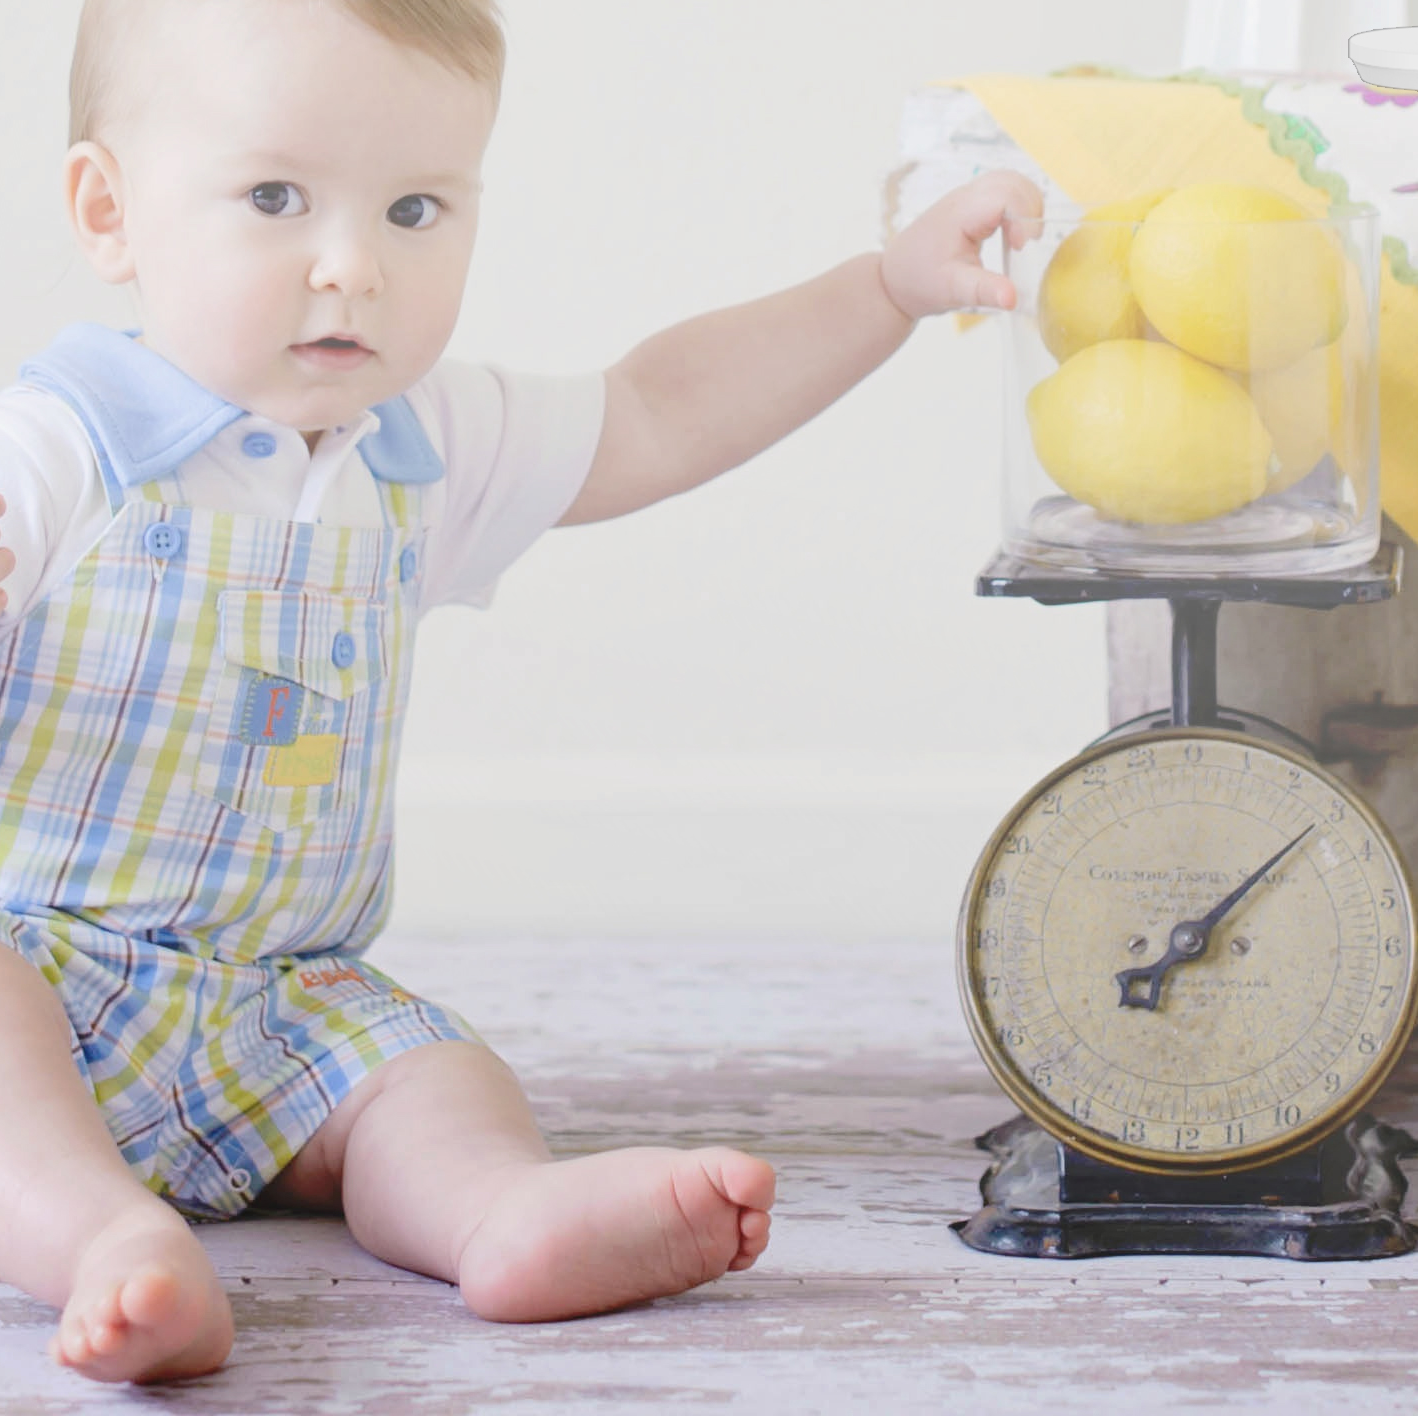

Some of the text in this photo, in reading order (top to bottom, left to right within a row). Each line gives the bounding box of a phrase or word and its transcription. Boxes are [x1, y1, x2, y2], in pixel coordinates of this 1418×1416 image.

[262, 686, 290, 737] F
[1184, 744, 1203, 763] 0
[1288, 767, 1302, 789] 2
[1330, 799, 1346, 823] 3
[1005, 835, 1030, 855] 20
[1380, 888, 1396, 910] 5
[1385, 936, 1403, 958] 6
[1378, 984, 1394, 1008] 7
[1357, 1032, 1376, 1055] 8
[1325, 1072, 1341, 1095] 9
[1275, 1103, 1302, 1127] 10
[1175, 1126, 1201, 1150] 12
